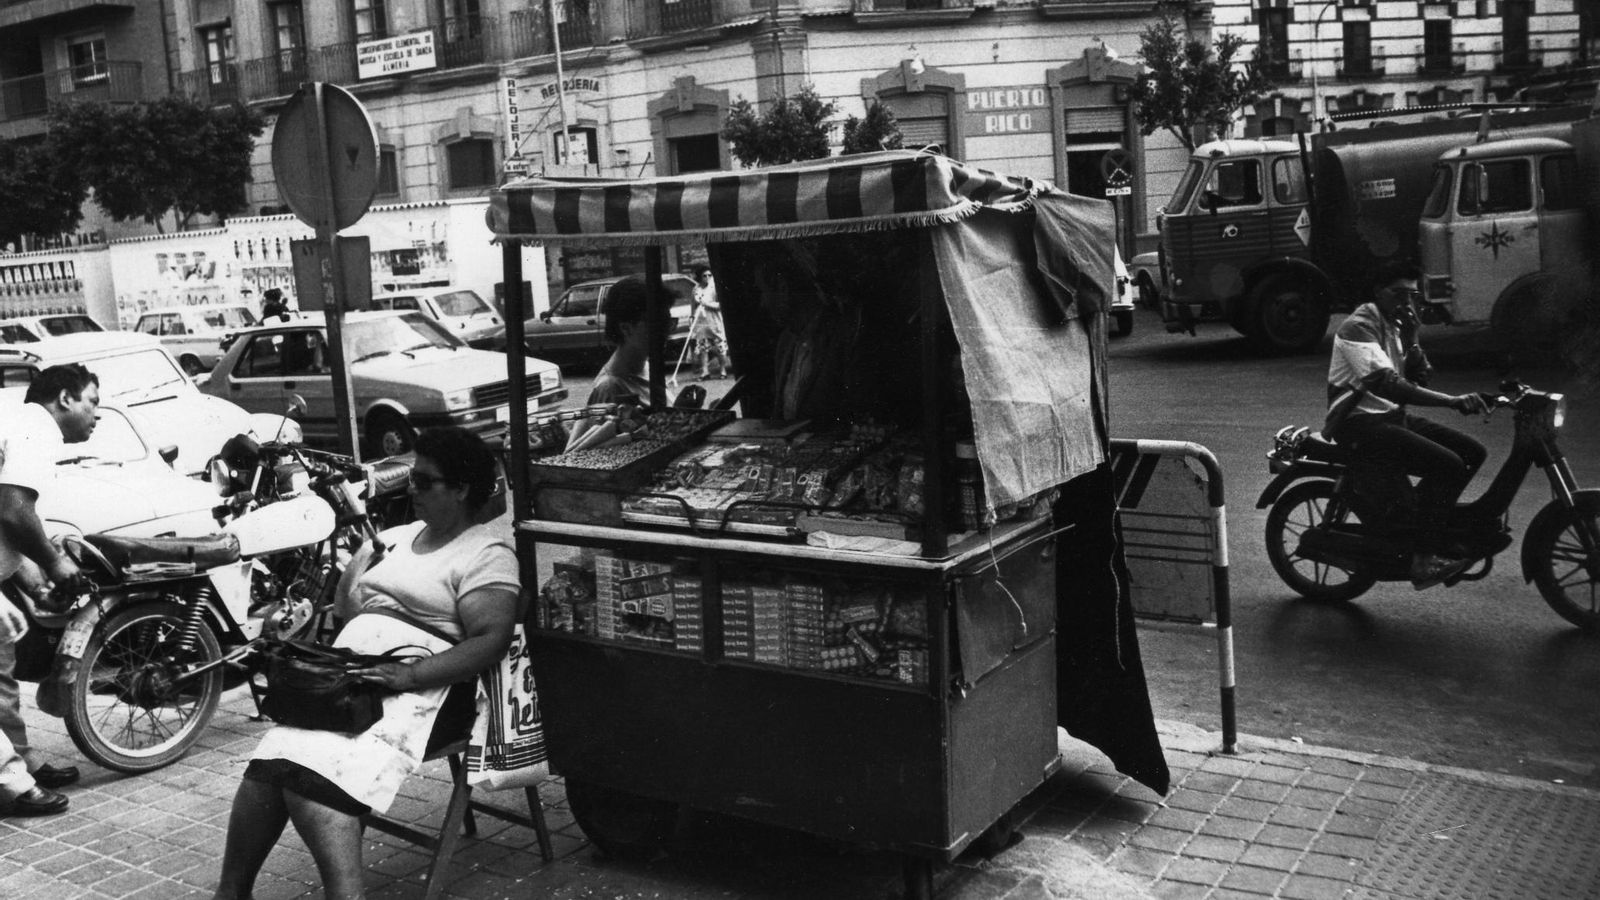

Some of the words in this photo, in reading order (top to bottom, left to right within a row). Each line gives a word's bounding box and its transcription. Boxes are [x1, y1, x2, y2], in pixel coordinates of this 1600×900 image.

[541, 78, 599, 99] RELOJERIA
[967, 88, 1045, 109] PUERTO
[507, 79, 521, 158] RELOJERIA
[985, 113, 1032, 133] RICO
